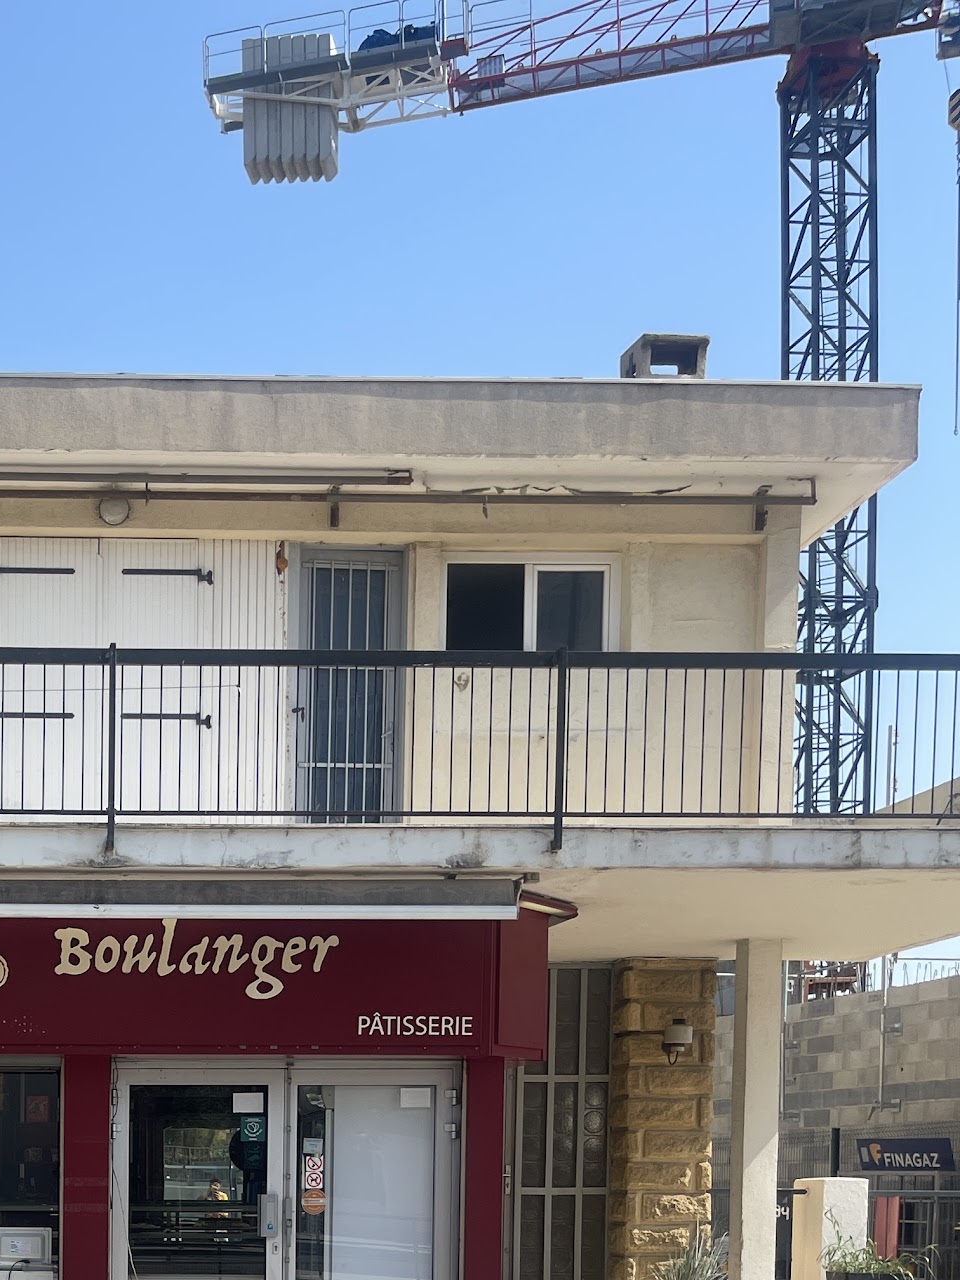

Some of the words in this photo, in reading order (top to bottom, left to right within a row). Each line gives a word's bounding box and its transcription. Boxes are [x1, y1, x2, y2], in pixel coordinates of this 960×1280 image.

[53, 918, 340, 1000] Boulanger
[356, 1012, 474, 1037] PÂTISSERIE
[883, 1152, 941, 1168] FINAGAZ
